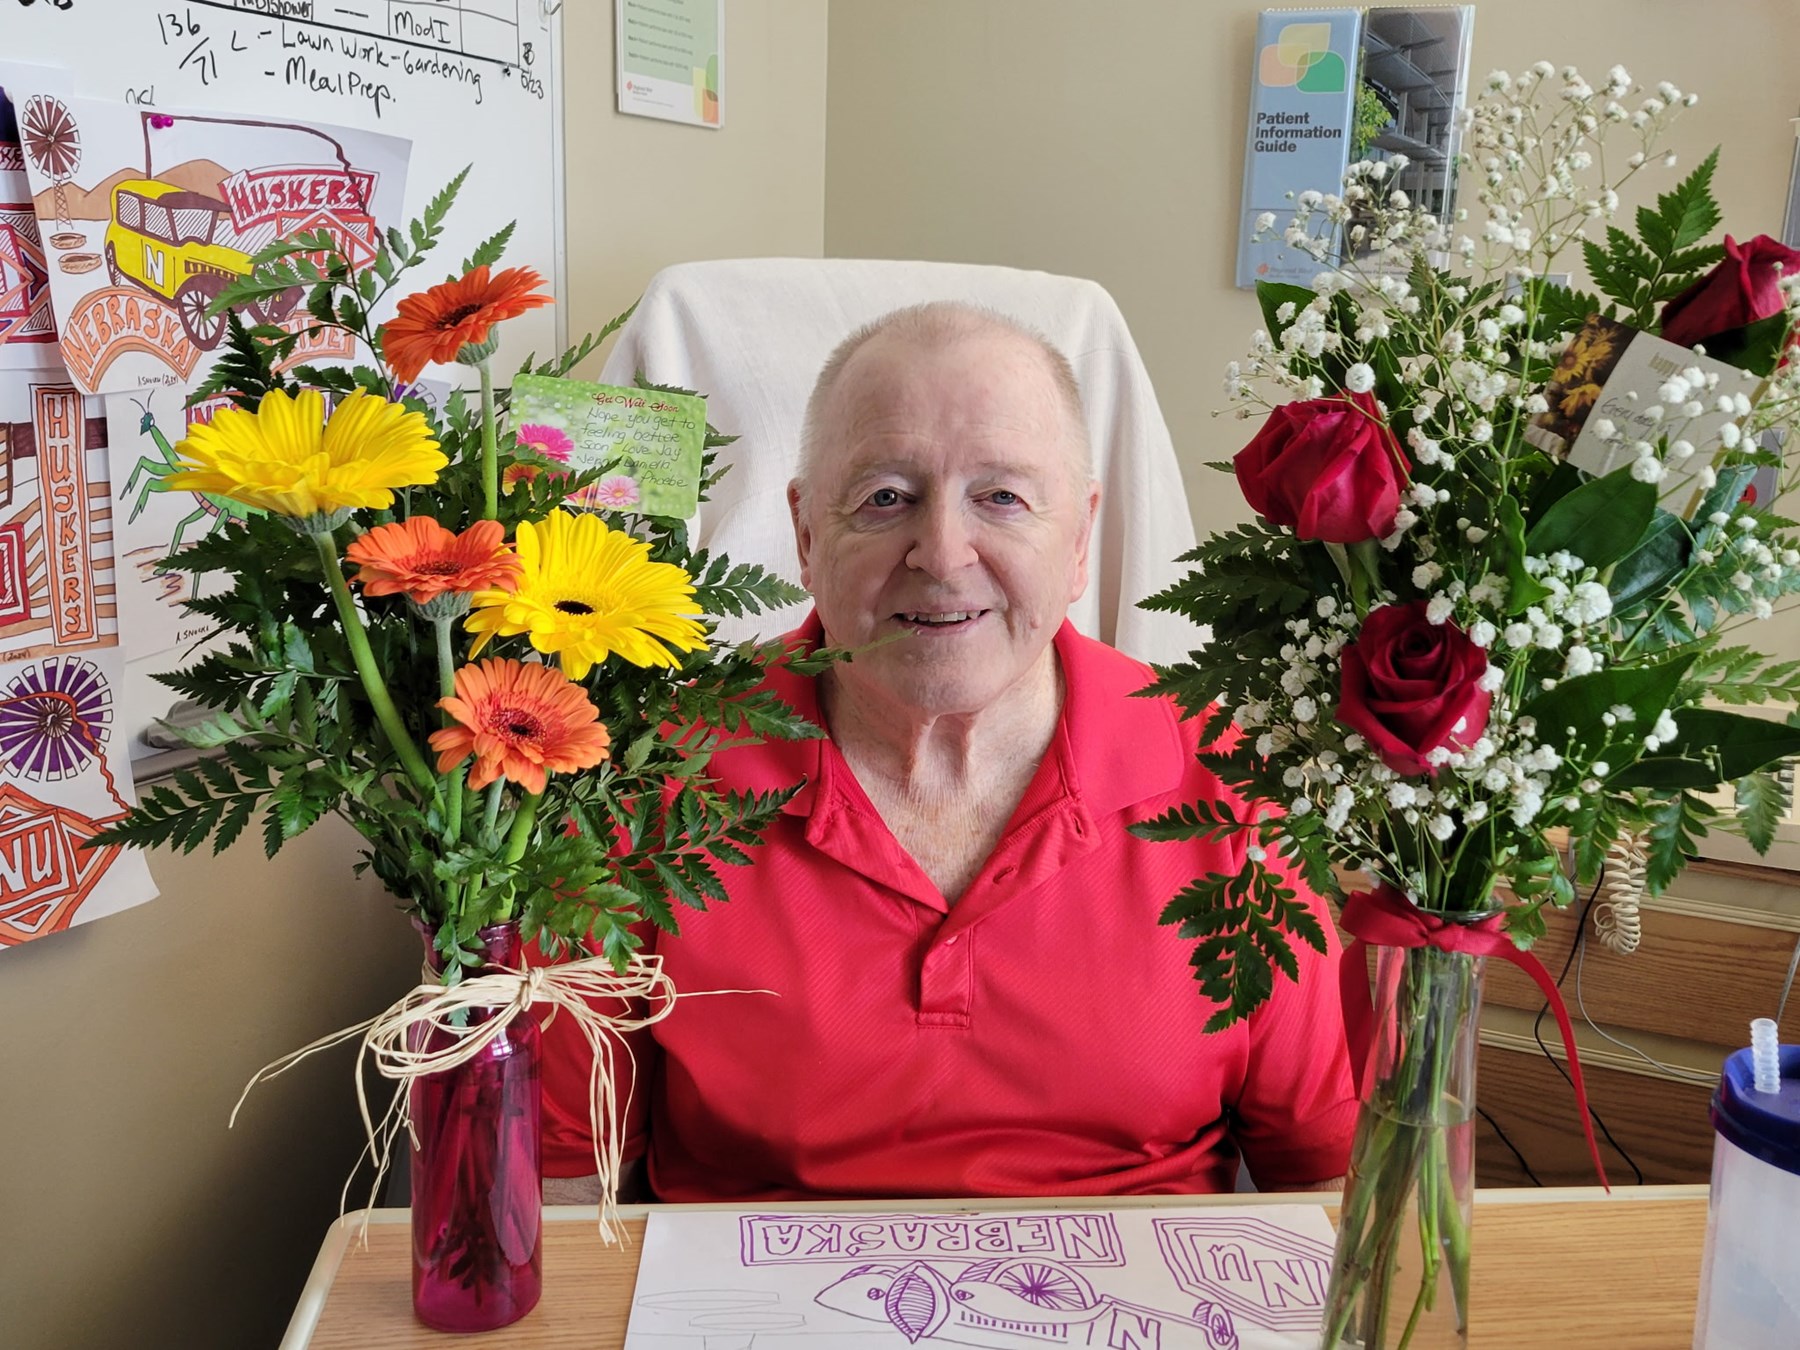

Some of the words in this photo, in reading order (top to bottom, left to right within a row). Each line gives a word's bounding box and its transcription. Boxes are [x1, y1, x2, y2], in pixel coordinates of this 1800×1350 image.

[157, 8, 201, 45] 136
[281, 22, 334, 52] Lawn
[1255, 126, 1342, 138] Information
[1256, 112, 1310, 124] Patient
[1254, 140, 1297, 152] Guide
[231, 180, 361, 222] HUSKERS
[145, 244, 166, 288] N
[61, 295, 191, 380] NEBRASKA
[592, 392, 613, 405] Get
[615, 395, 645, 408] Well
[648, 402, 679, 413] Soon
[587, 407, 619, 423] Hope
[625, 414, 650, 429] you
[652, 415, 676, 430] get
[622, 442, 652, 455] Love
[656, 444, 682, 462] Jay
[47, 396, 83, 633] HUSKERS
[761, 1216, 1108, 1260] NEBRASKA
